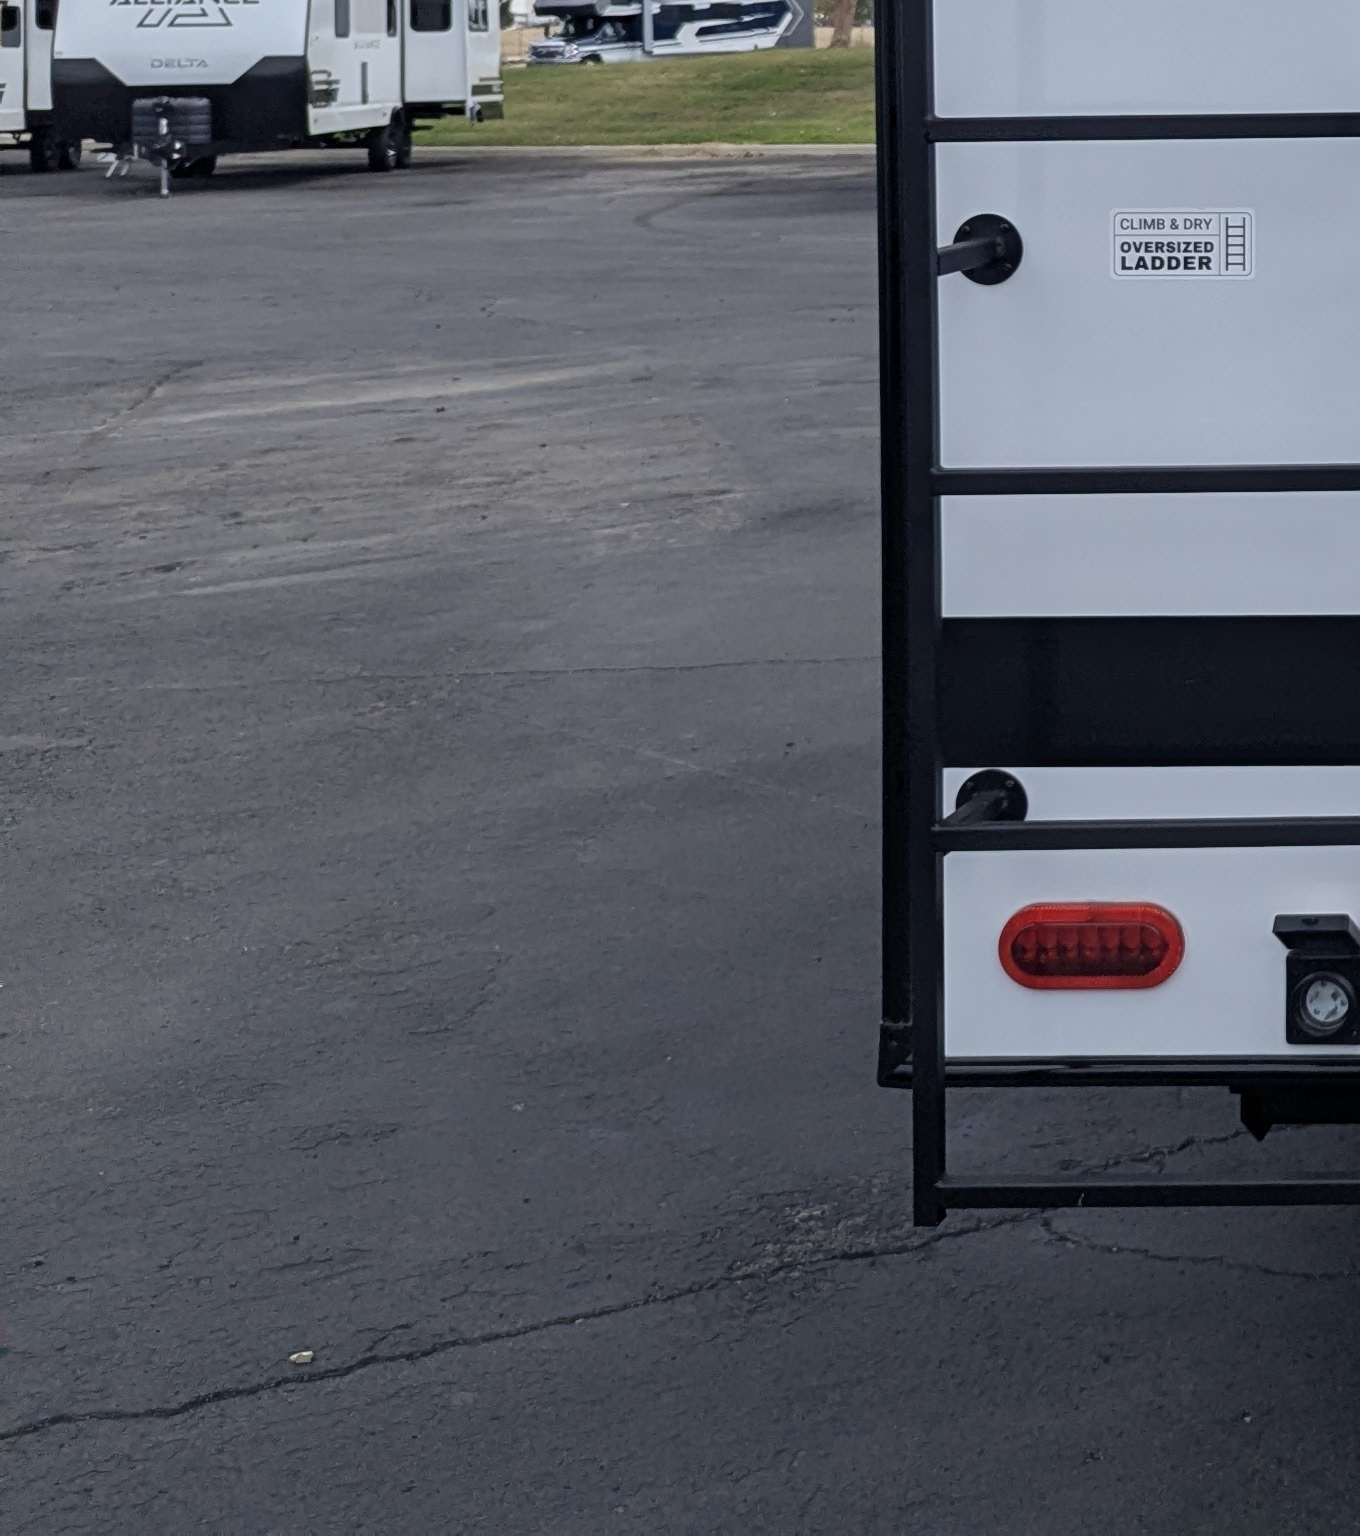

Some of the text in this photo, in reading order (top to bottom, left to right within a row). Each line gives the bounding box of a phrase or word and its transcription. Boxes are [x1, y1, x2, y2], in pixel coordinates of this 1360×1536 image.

[150, 58, 208, 69] DELTA
[1120, 218, 1213, 230] CLIMB & DRY
[1120, 241, 1215, 253] OVERSIZED
[1120, 256, 1213, 270] LADDER
